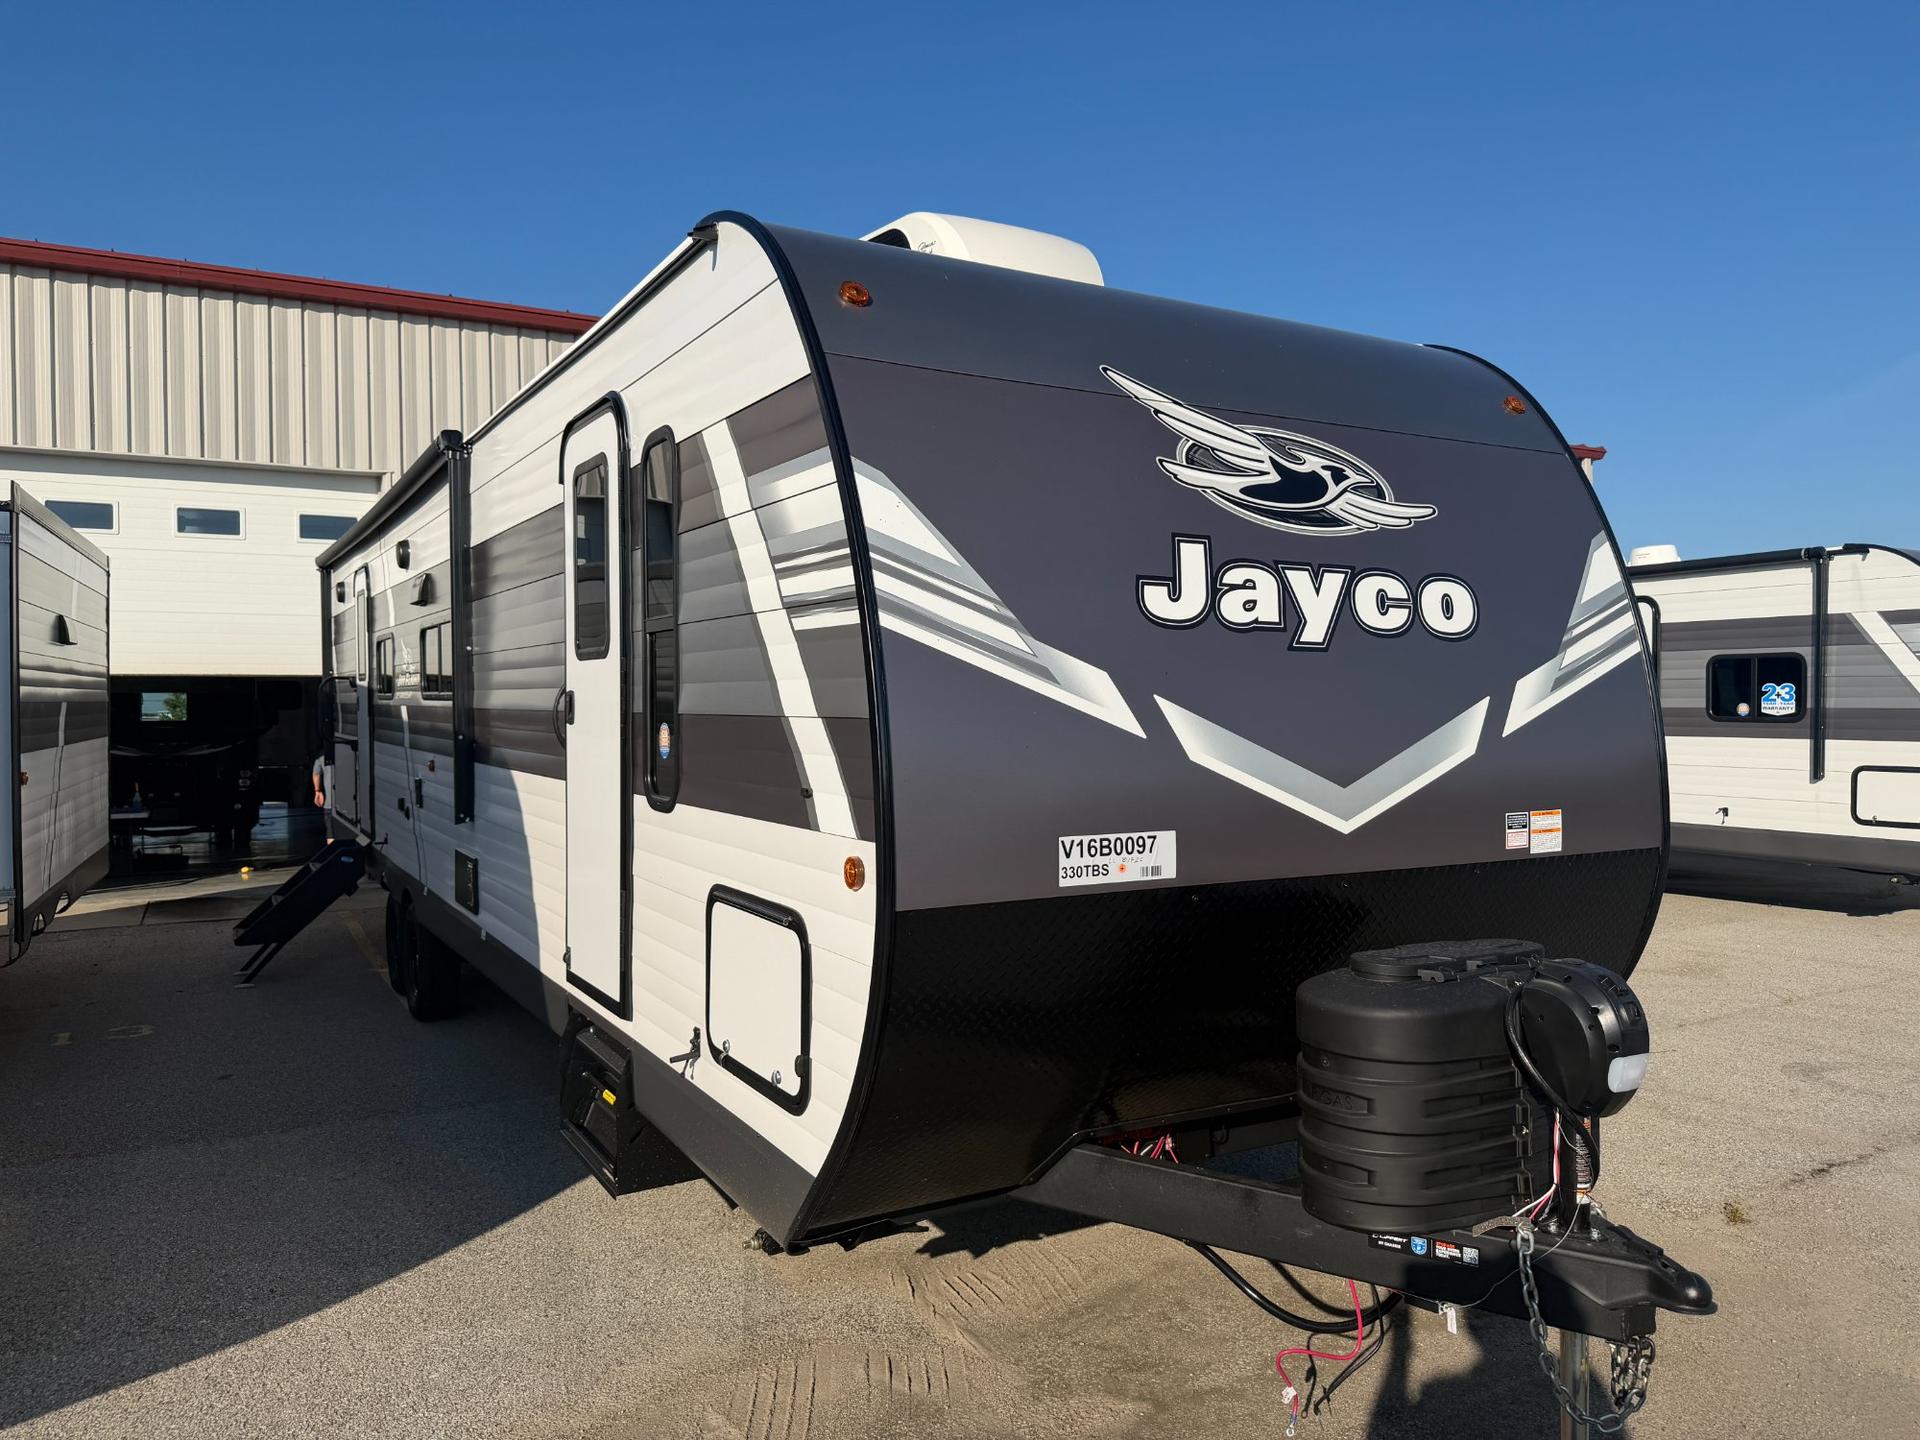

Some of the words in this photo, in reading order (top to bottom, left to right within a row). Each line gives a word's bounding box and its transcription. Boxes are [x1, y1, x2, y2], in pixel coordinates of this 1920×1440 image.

[1137, 533, 1479, 651] Jayco
[1060, 835, 1157, 859] V16B0097
[1061, 864, 1110, 879] 330TBS
